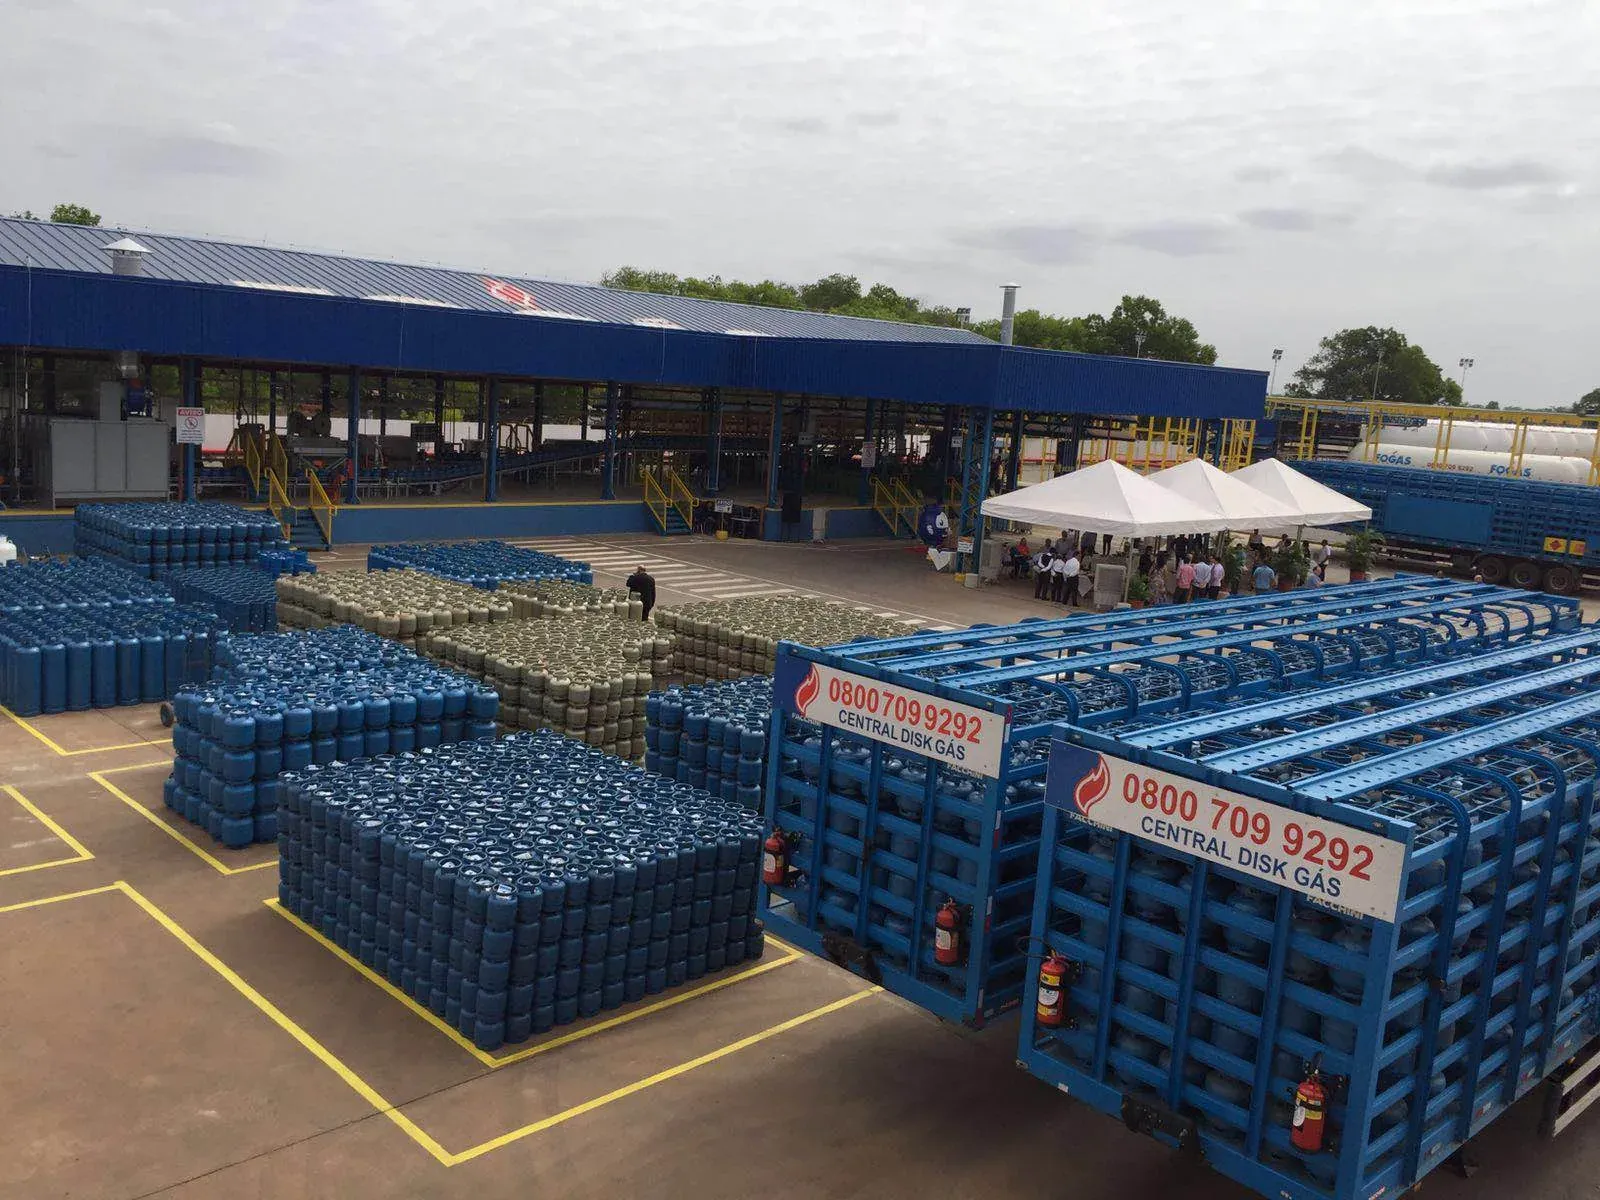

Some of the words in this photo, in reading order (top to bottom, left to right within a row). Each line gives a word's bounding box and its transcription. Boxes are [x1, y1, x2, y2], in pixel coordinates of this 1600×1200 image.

[829, 677, 879, 713] 0800
[882, 691, 921, 725] 709
[924, 704, 982, 743] 9292
[839, 709, 898, 741] CENTRAL
[901, 728, 932, 752] DISK
[935, 739, 965, 760] GÁS
[1123, 773, 1198, 821] 0800
[1211, 798, 1271, 845] 709
[1283, 822, 1375, 880] 9292
[1141, 816, 1232, 861] CENTRAL
[1238, 846, 1287, 880] DISK
[1294, 867, 1342, 898] GÁS
